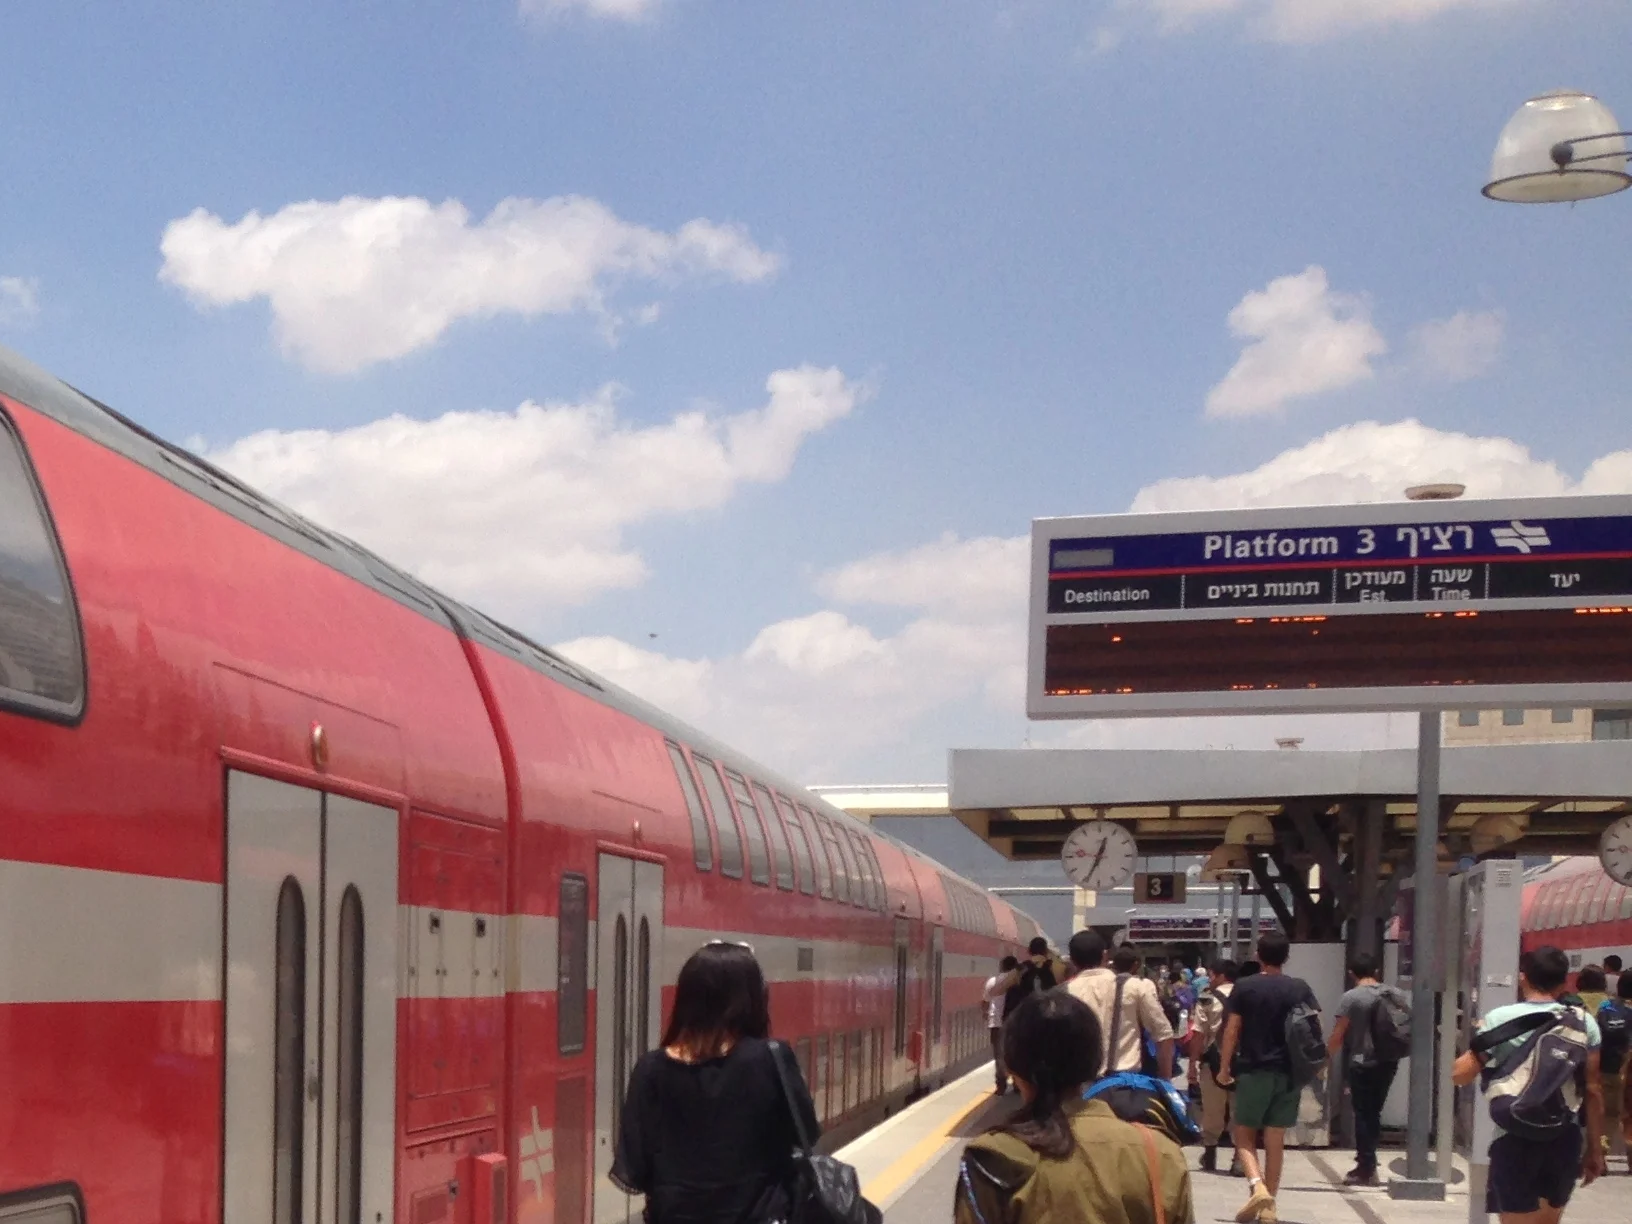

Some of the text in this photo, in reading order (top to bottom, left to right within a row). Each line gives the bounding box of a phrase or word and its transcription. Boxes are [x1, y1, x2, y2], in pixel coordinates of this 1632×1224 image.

[1204, 529, 1376, 559] Platform 3
[1397, 525, 1473, 558] רציף
[1344, 570, 1406, 589] מעודכן
[1430, 568, 1472, 583] שעה
[1550, 573, 1581, 588] יעד
[1065, 588, 1150, 603] Destination
[1207, 581, 1320, 599] תחנות ביניים
[1431, 587, 1471, 601] Time
[1150, 878, 1162, 896] 3
